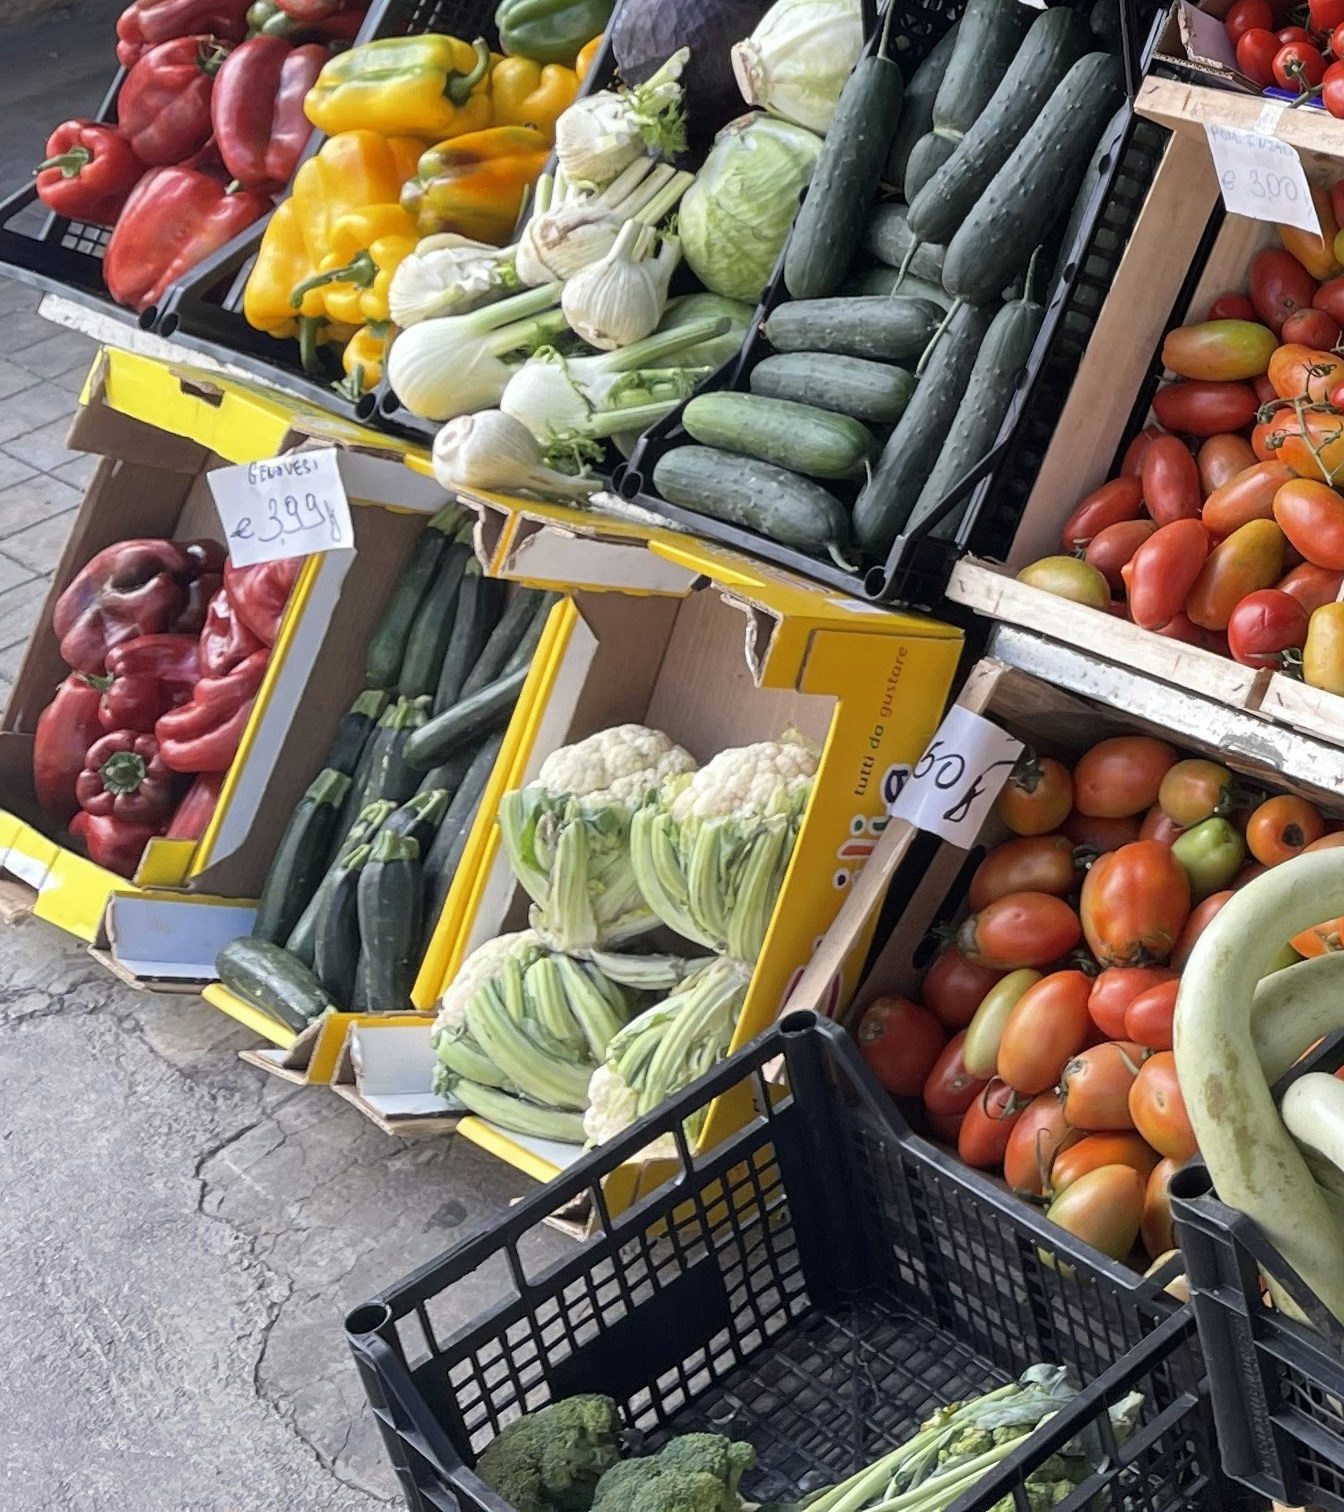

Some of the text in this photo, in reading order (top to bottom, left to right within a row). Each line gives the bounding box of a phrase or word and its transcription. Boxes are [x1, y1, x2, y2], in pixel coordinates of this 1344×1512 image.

[854, 646, 908, 797] tutti da gustare
